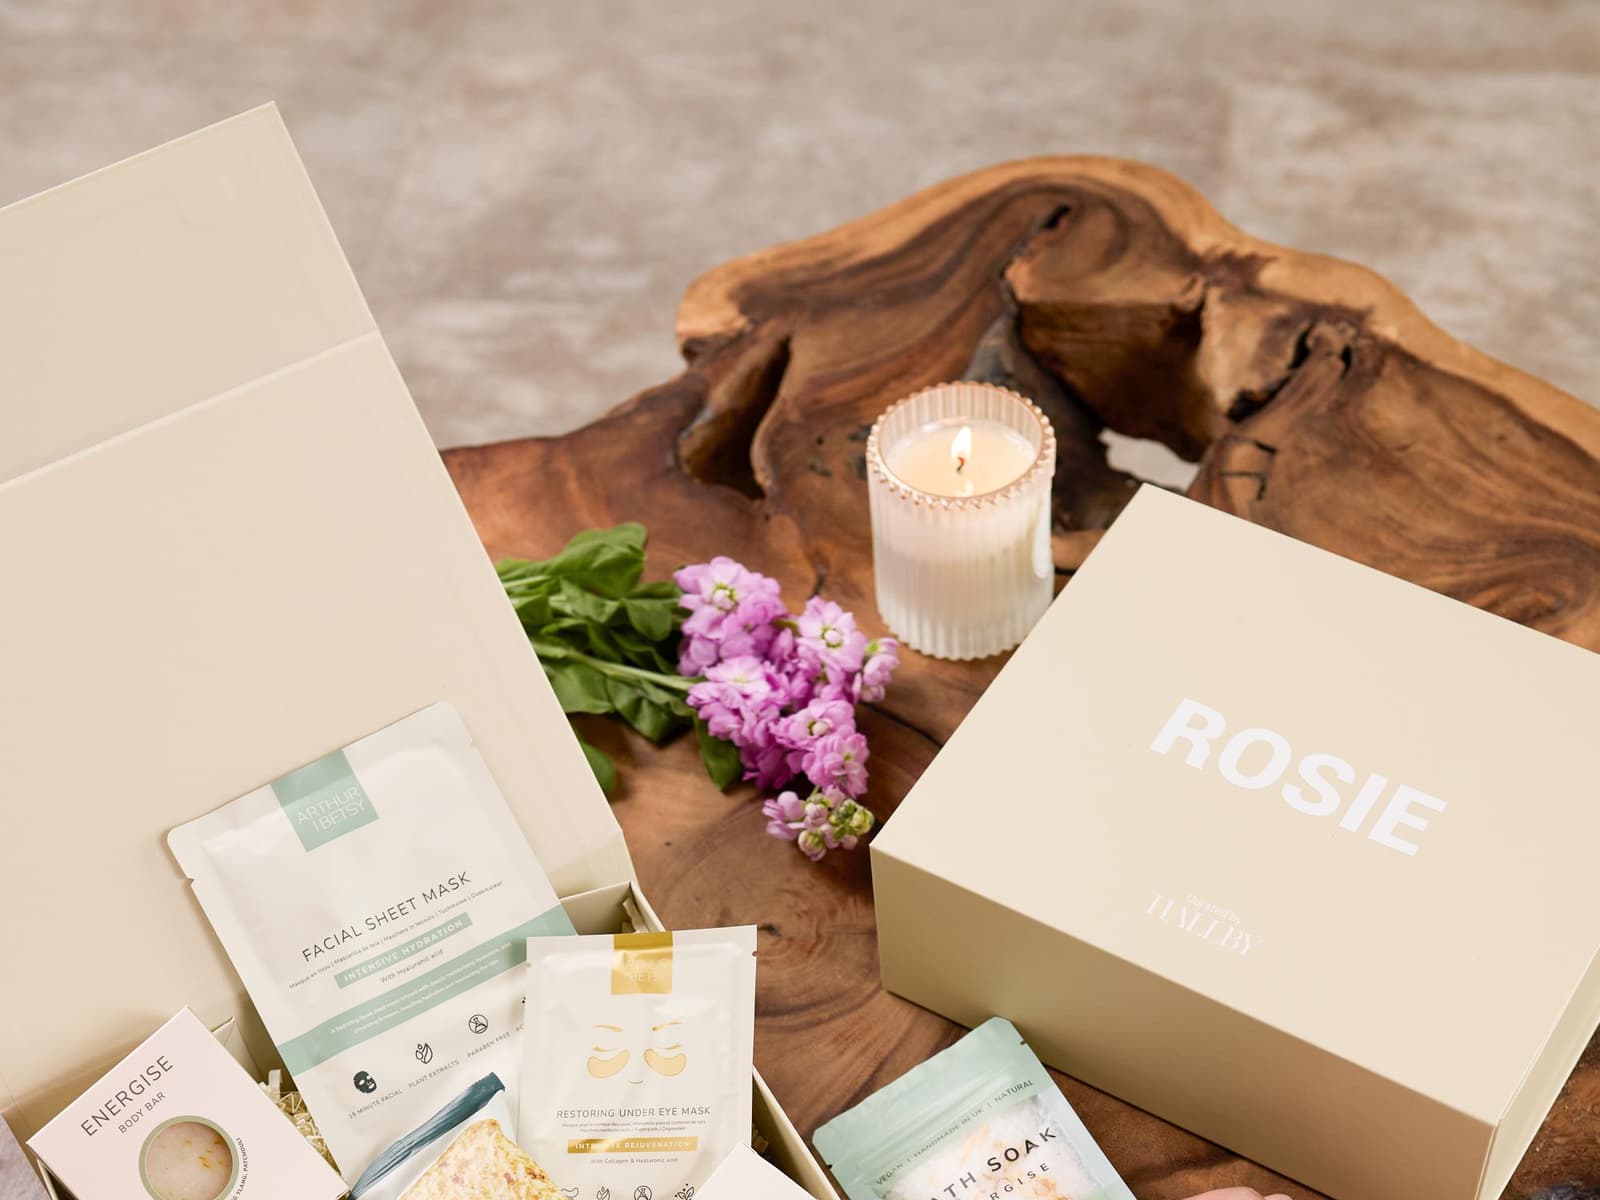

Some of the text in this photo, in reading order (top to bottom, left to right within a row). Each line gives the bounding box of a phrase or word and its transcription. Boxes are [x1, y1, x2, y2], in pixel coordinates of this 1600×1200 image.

[1148, 691, 1449, 862] ROSIE
[296, 785, 360, 824] ARTHUR
[302, 871, 470, 962] FACIAL SHEET MASK
[342, 918, 464, 984] INTENSIVE HYDRATION
[407, 1058, 459, 1088] PLANT EXTRACTS
[81, 1056, 173, 1136] ENERGISE
[117, 1090, 165, 1133] BODY BAR
[356, 1098, 379, 1115] MINUTE
[379, 1087, 402, 1103] FACIAL
[556, 1105, 711, 1118] RESTORING UNDER EYE MASK
[876, 1161, 902, 1185] VEGAN
[914, 1125, 958, 1159] HANDMADE
[995, 1080, 1032, 1100] NATURAL
[987, 1128, 1056, 1172] SOAK
[236, 1138, 248, 1171] PATCHOULI
